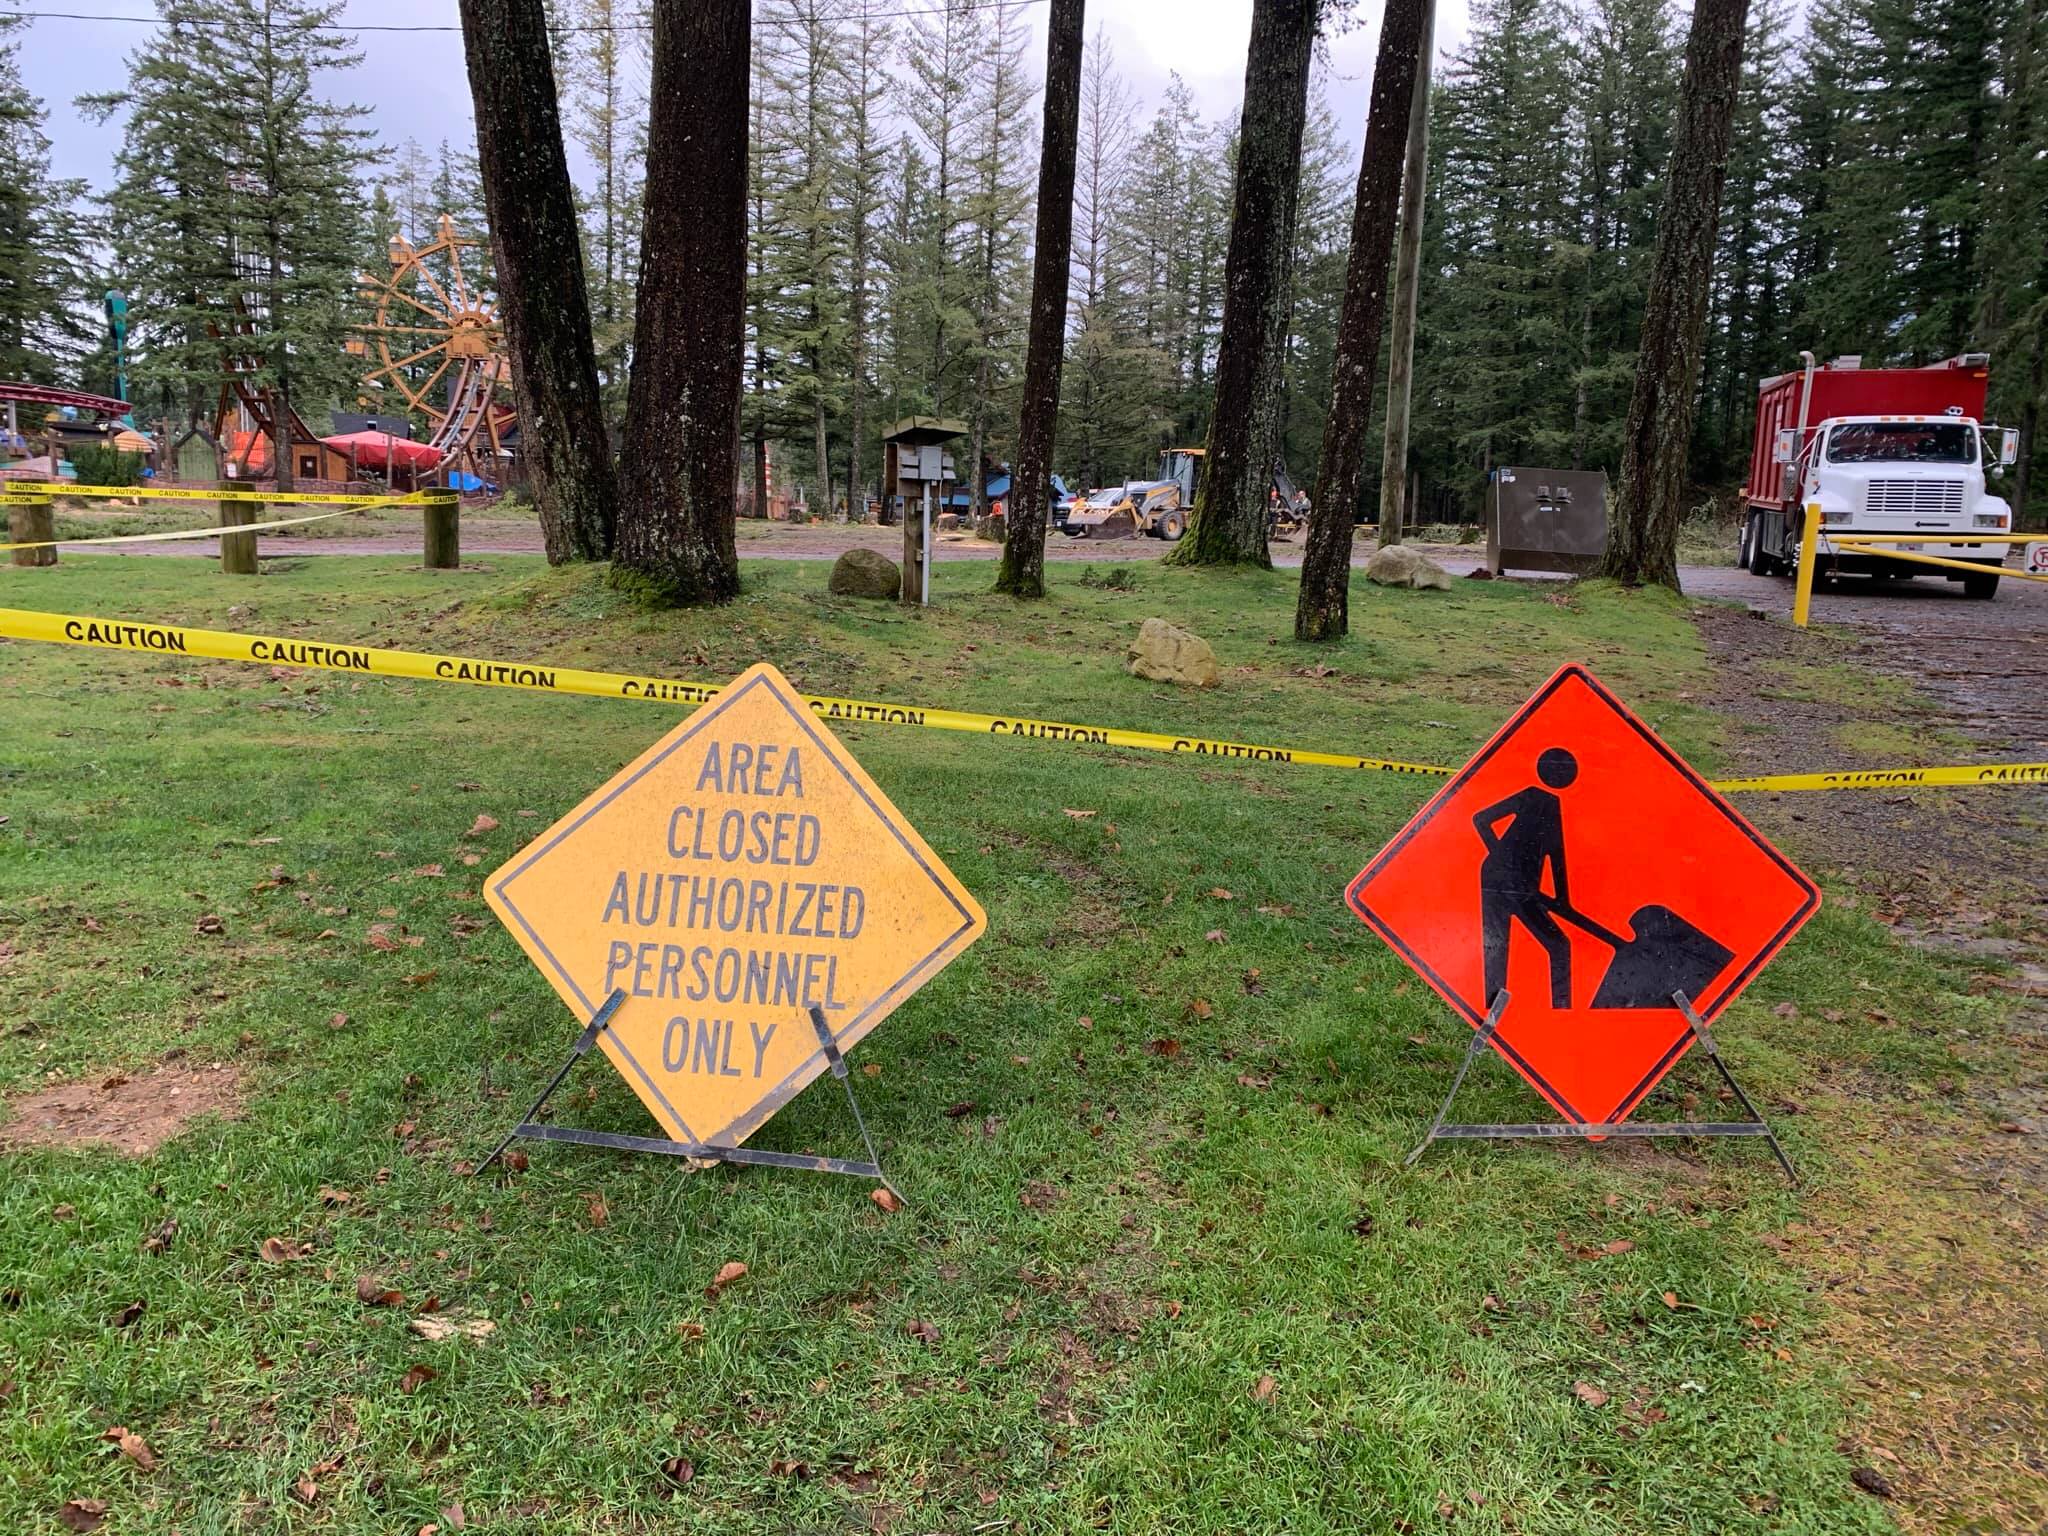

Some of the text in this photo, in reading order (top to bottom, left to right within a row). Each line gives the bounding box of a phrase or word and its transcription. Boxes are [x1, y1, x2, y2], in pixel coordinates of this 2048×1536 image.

[10, 483, 42, 491] CAUTION
[59, 485, 93, 494] CAUTION
[109, 487, 142, 496] CAUTION
[158, 489, 191, 497] CAUTION
[206, 491, 238, 499] CAUTION
[300, 494, 330, 502] CAUTION
[345, 495, 375, 503] CAUTION
[65, 620, 187, 651] CAUTION
[250, 641, 371, 670] CAUTION
[435, 660, 556, 688] CAUTION
[621, 680, 720, 703] CAUTI
[696, 741, 804, 798] AREA
[666, 806, 821, 867] CLOSED
[602, 871, 865, 940] AUTHORIZED
[603, 940, 846, 1010] PERSONNEL
[662, 1016, 778, 1078] ONLY
